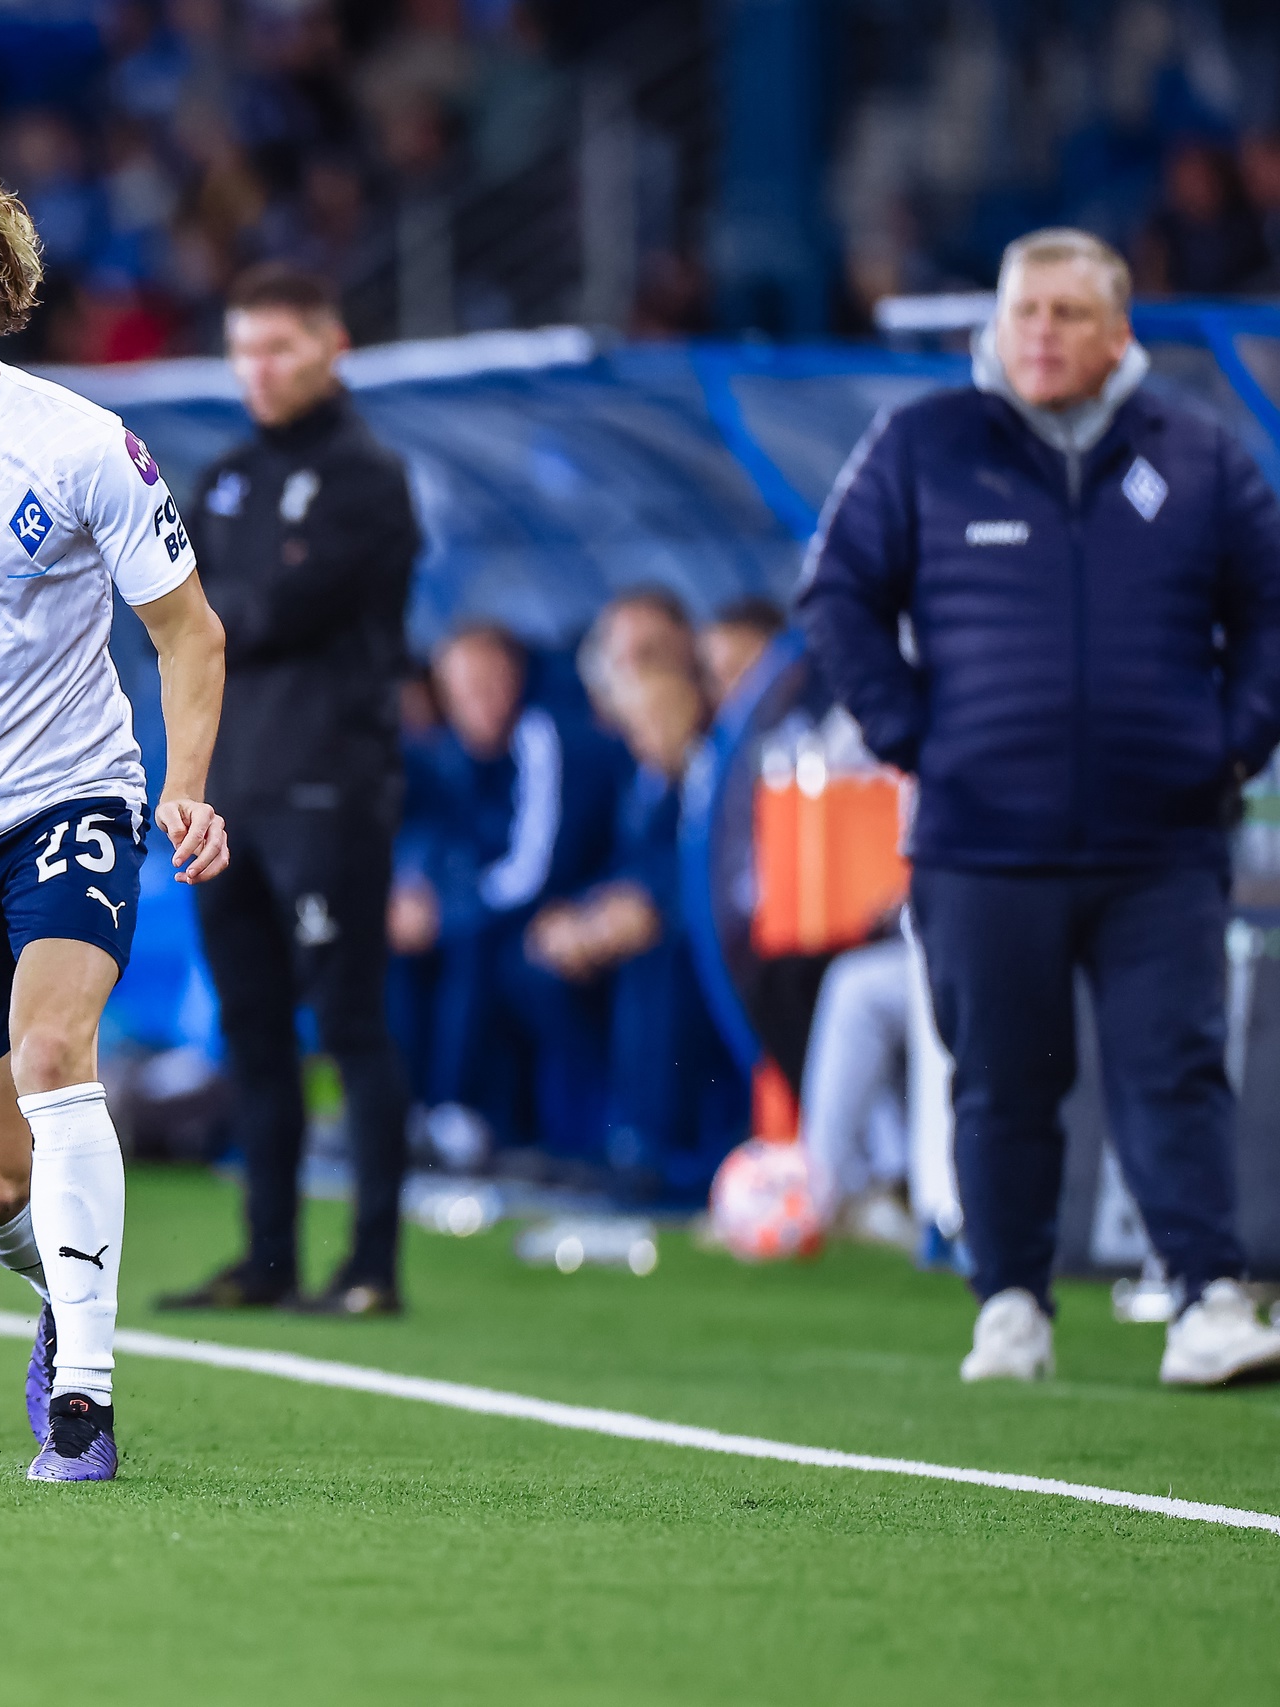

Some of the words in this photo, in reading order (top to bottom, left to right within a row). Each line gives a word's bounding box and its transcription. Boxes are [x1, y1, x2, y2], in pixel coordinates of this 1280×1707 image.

[154, 494, 177, 538] FO
[164, 520, 188, 563] BE
[34, 812, 117, 884] 25
